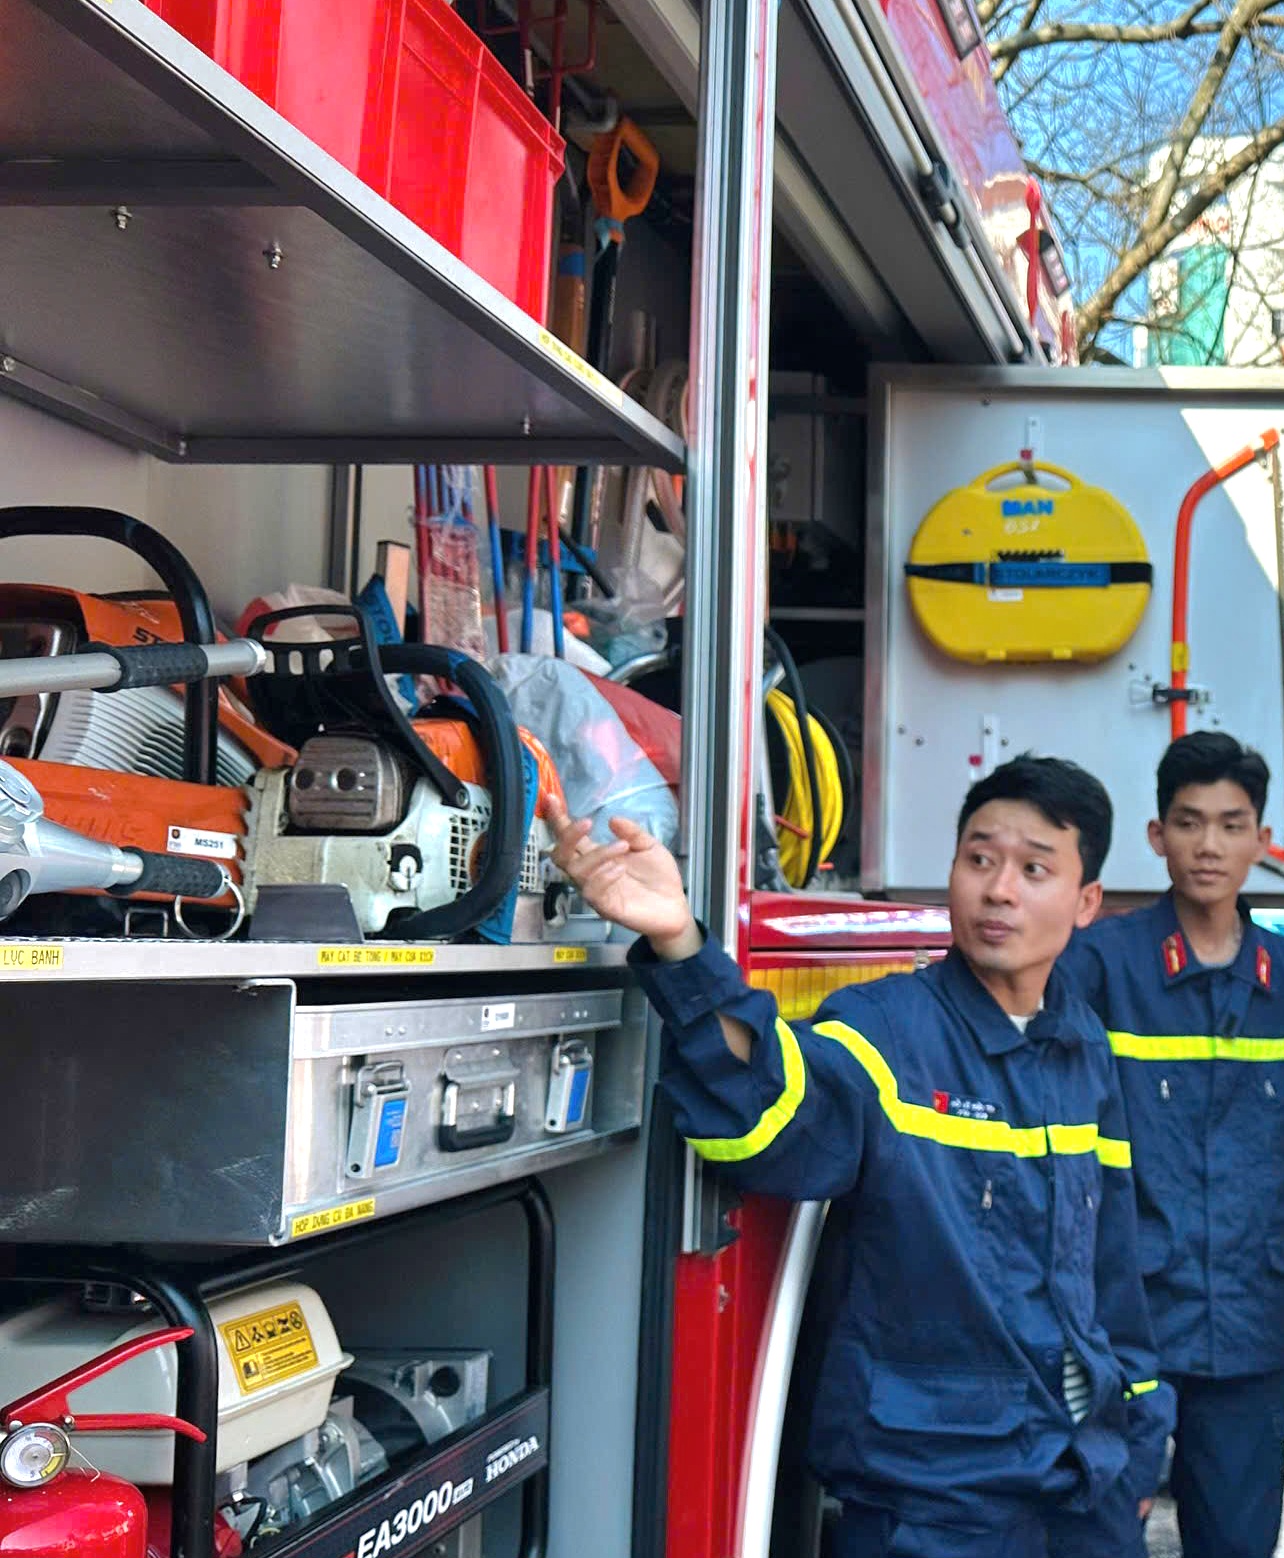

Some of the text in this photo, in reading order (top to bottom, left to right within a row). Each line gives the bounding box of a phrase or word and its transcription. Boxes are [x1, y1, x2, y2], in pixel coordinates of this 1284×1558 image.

[194, 838, 223, 849] MS251
[485, 1436, 539, 1483] HONDA
[357, 1481, 453, 1558] EA3000
